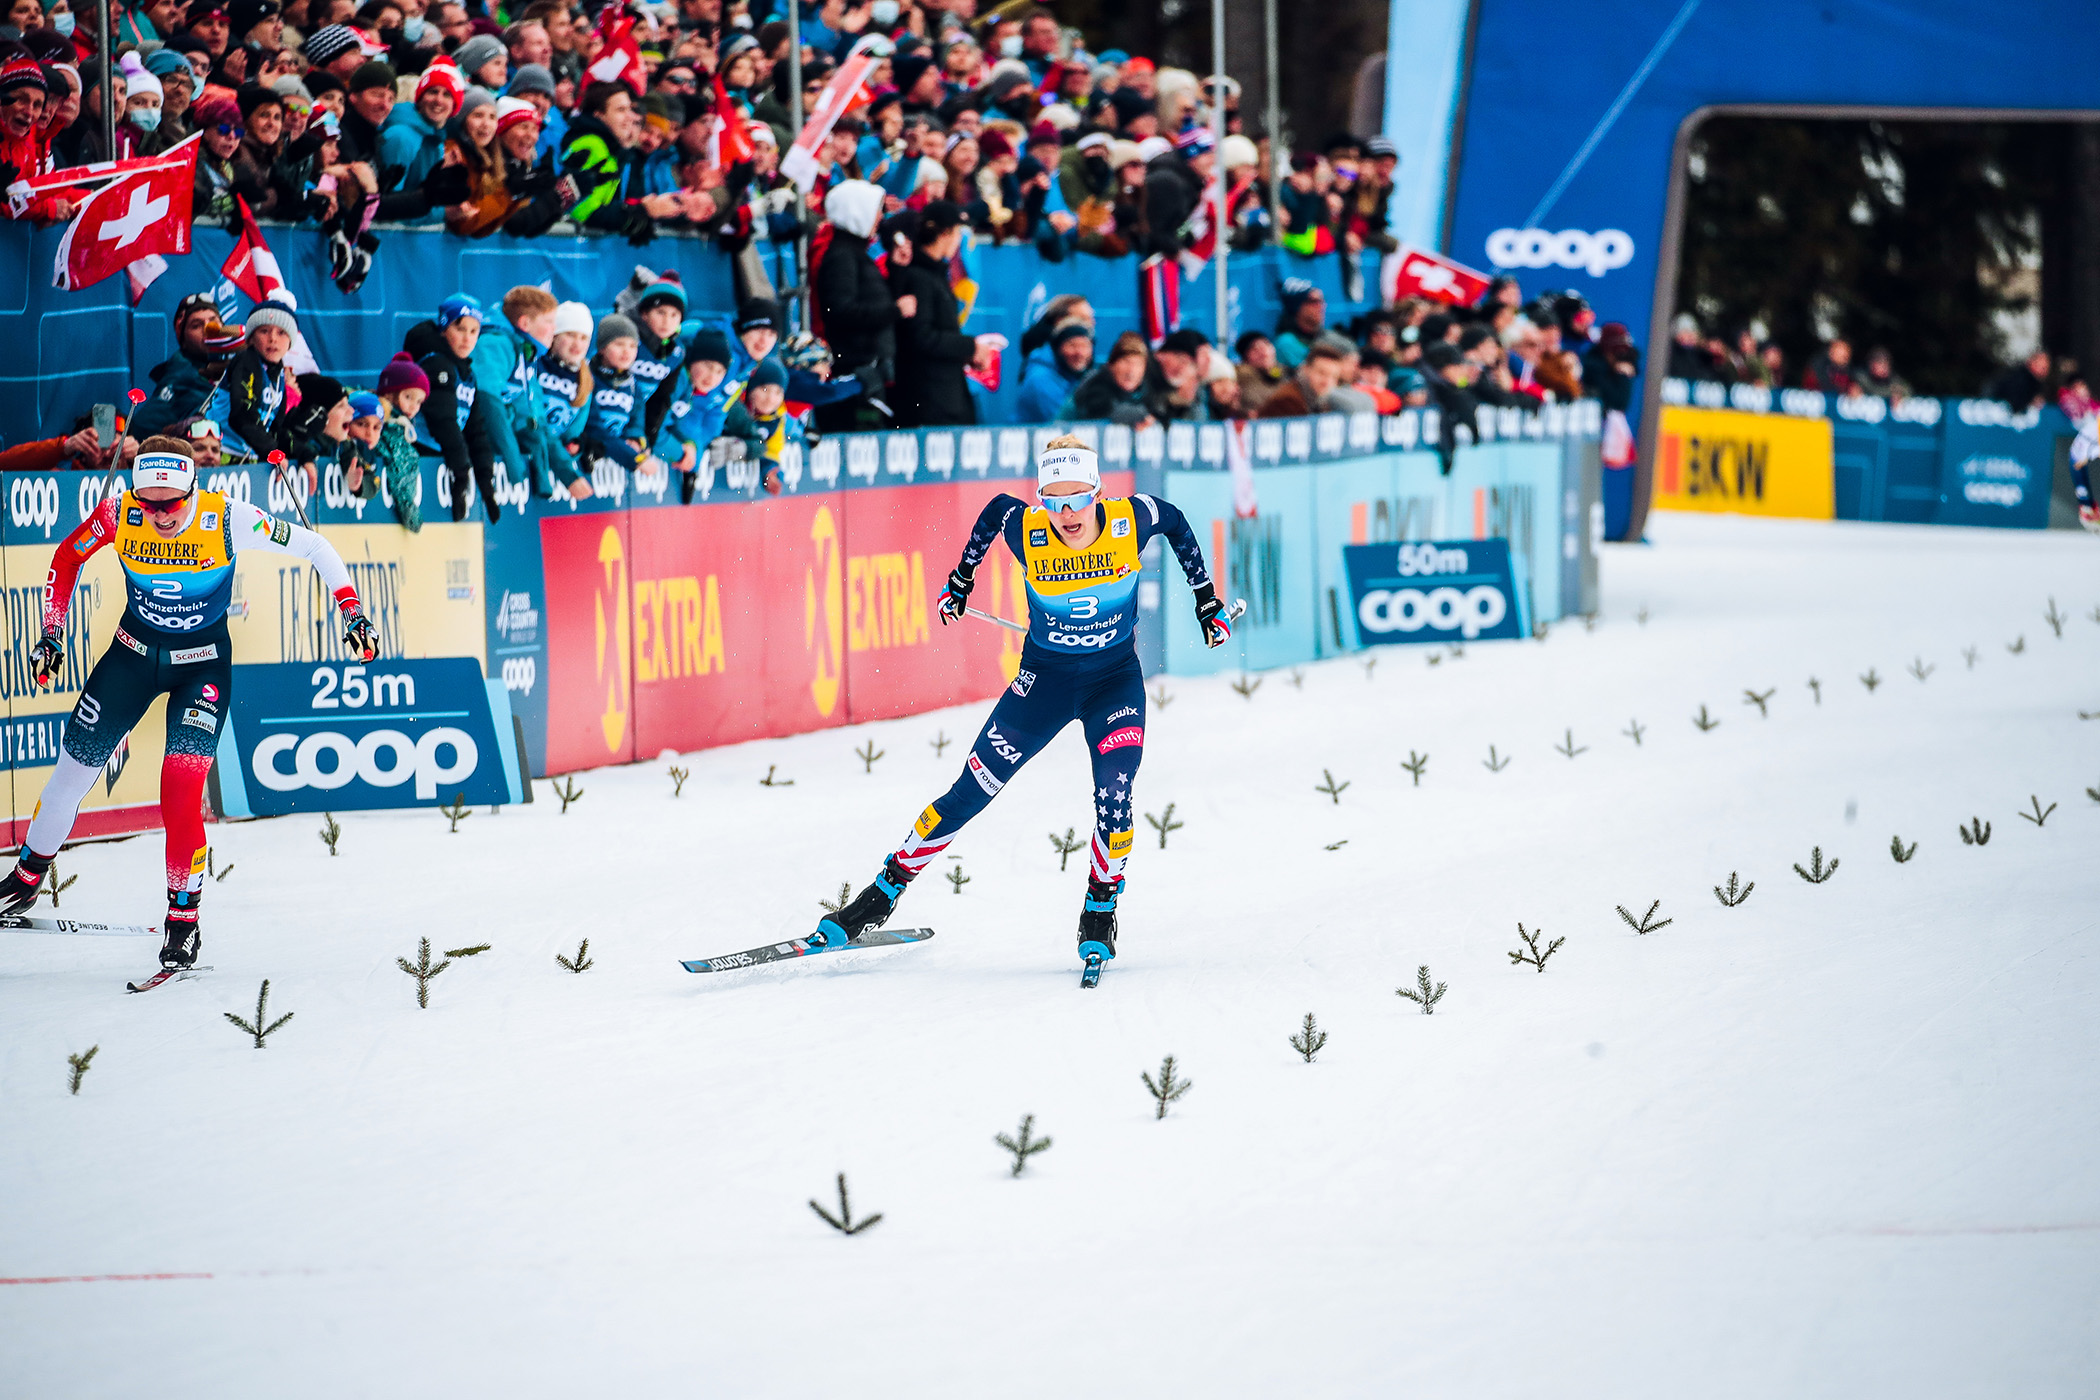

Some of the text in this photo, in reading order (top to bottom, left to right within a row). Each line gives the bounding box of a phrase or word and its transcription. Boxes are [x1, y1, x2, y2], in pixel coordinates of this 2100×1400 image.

[1486, 227, 1635, 278] coop
[595, 389, 634, 413] coop
[140, 459, 179, 469] SpareBank
[1041, 456, 1067, 469] Allianz
[10, 477, 60, 539] coop
[123, 539, 200, 558] LE GRUYÈRE
[1398, 543, 1469, 576] 50m
[1034, 551, 1113, 574] LE GRUYÈRE
[151, 579, 183, 600] 2
[847, 551, 930, 652] EXTRA
[1069, 596, 1099, 619] 3
[1359, 585, 1507, 639] coop
[138, 604, 204, 630] coop
[279, 567, 302, 663] LE
[1059, 613, 1123, 631] Lenzerheide
[117, 629, 136, 648] PAR
[635, 573, 725, 683] EXTRA
[1048, 628, 1117, 648] coop
[0, 583, 93, 700] GRURE
[175, 649, 213, 660] Scandic
[311, 665, 416, 709] 25m
[502, 656, 536, 697] coop
[194, 698, 218, 714] viaplay
[1106, 705, 1139, 725] swix
[987, 720, 1023, 765] VISA
[1101, 730, 1141, 750] xfinity
[252, 727, 479, 800] coop
[1120, 857, 1128, 871] 3
[197, 873, 204, 888] 2
